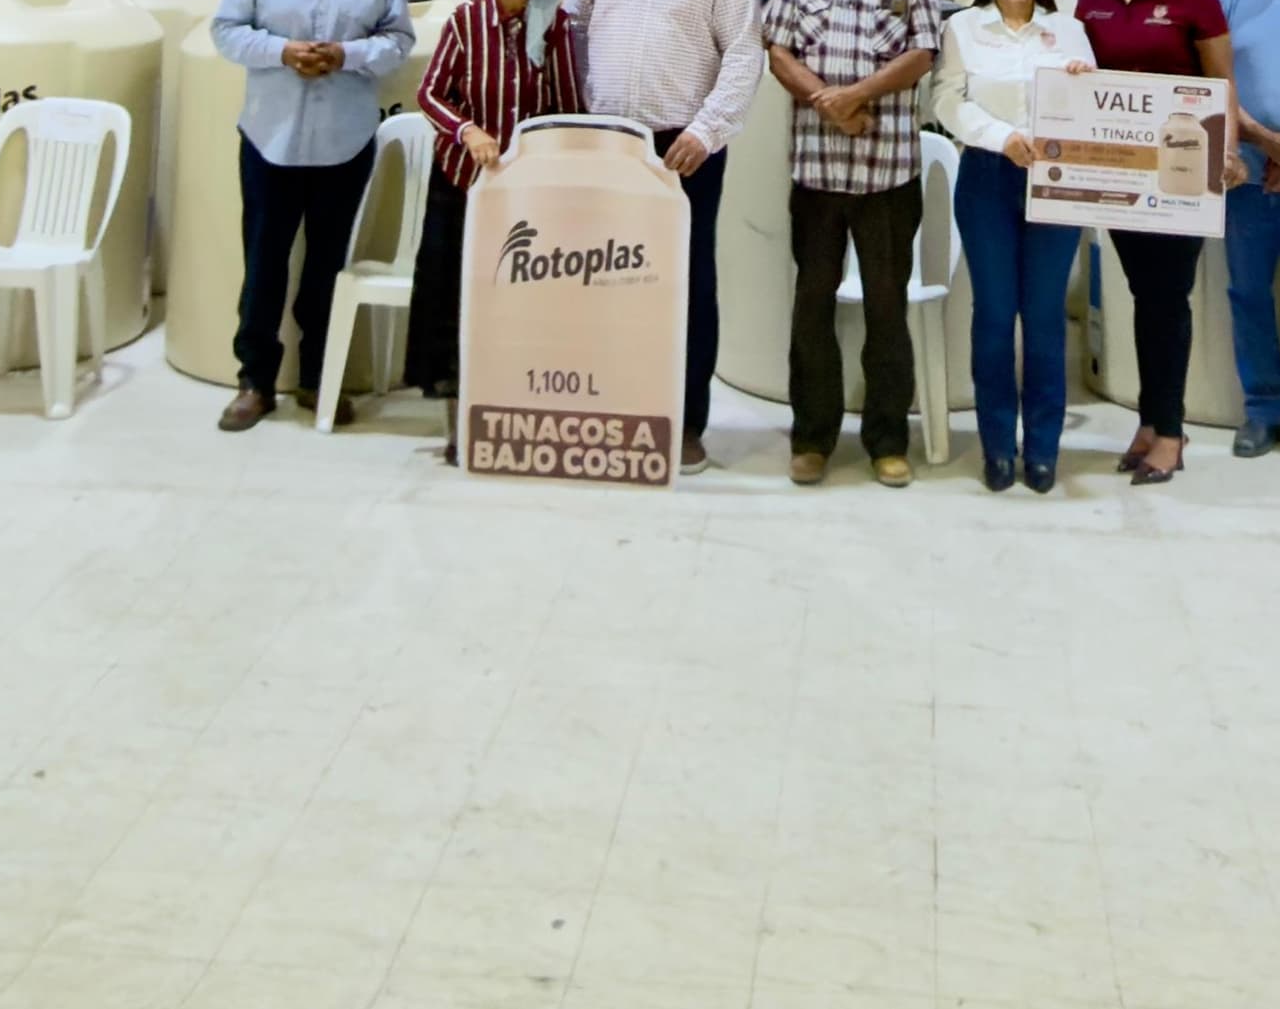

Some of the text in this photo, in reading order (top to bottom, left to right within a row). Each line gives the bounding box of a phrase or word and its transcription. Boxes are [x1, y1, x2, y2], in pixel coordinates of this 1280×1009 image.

[1094, 90, 1153, 114] VALE
[1091, 127, 1155, 143] 1 TINACO
[510, 238, 646, 286] Rotoplas
[526, 369, 600, 395] 1,100 L
[482, 410, 657, 450] TINACOS A
[473, 440, 668, 481] BAJO COSTO
